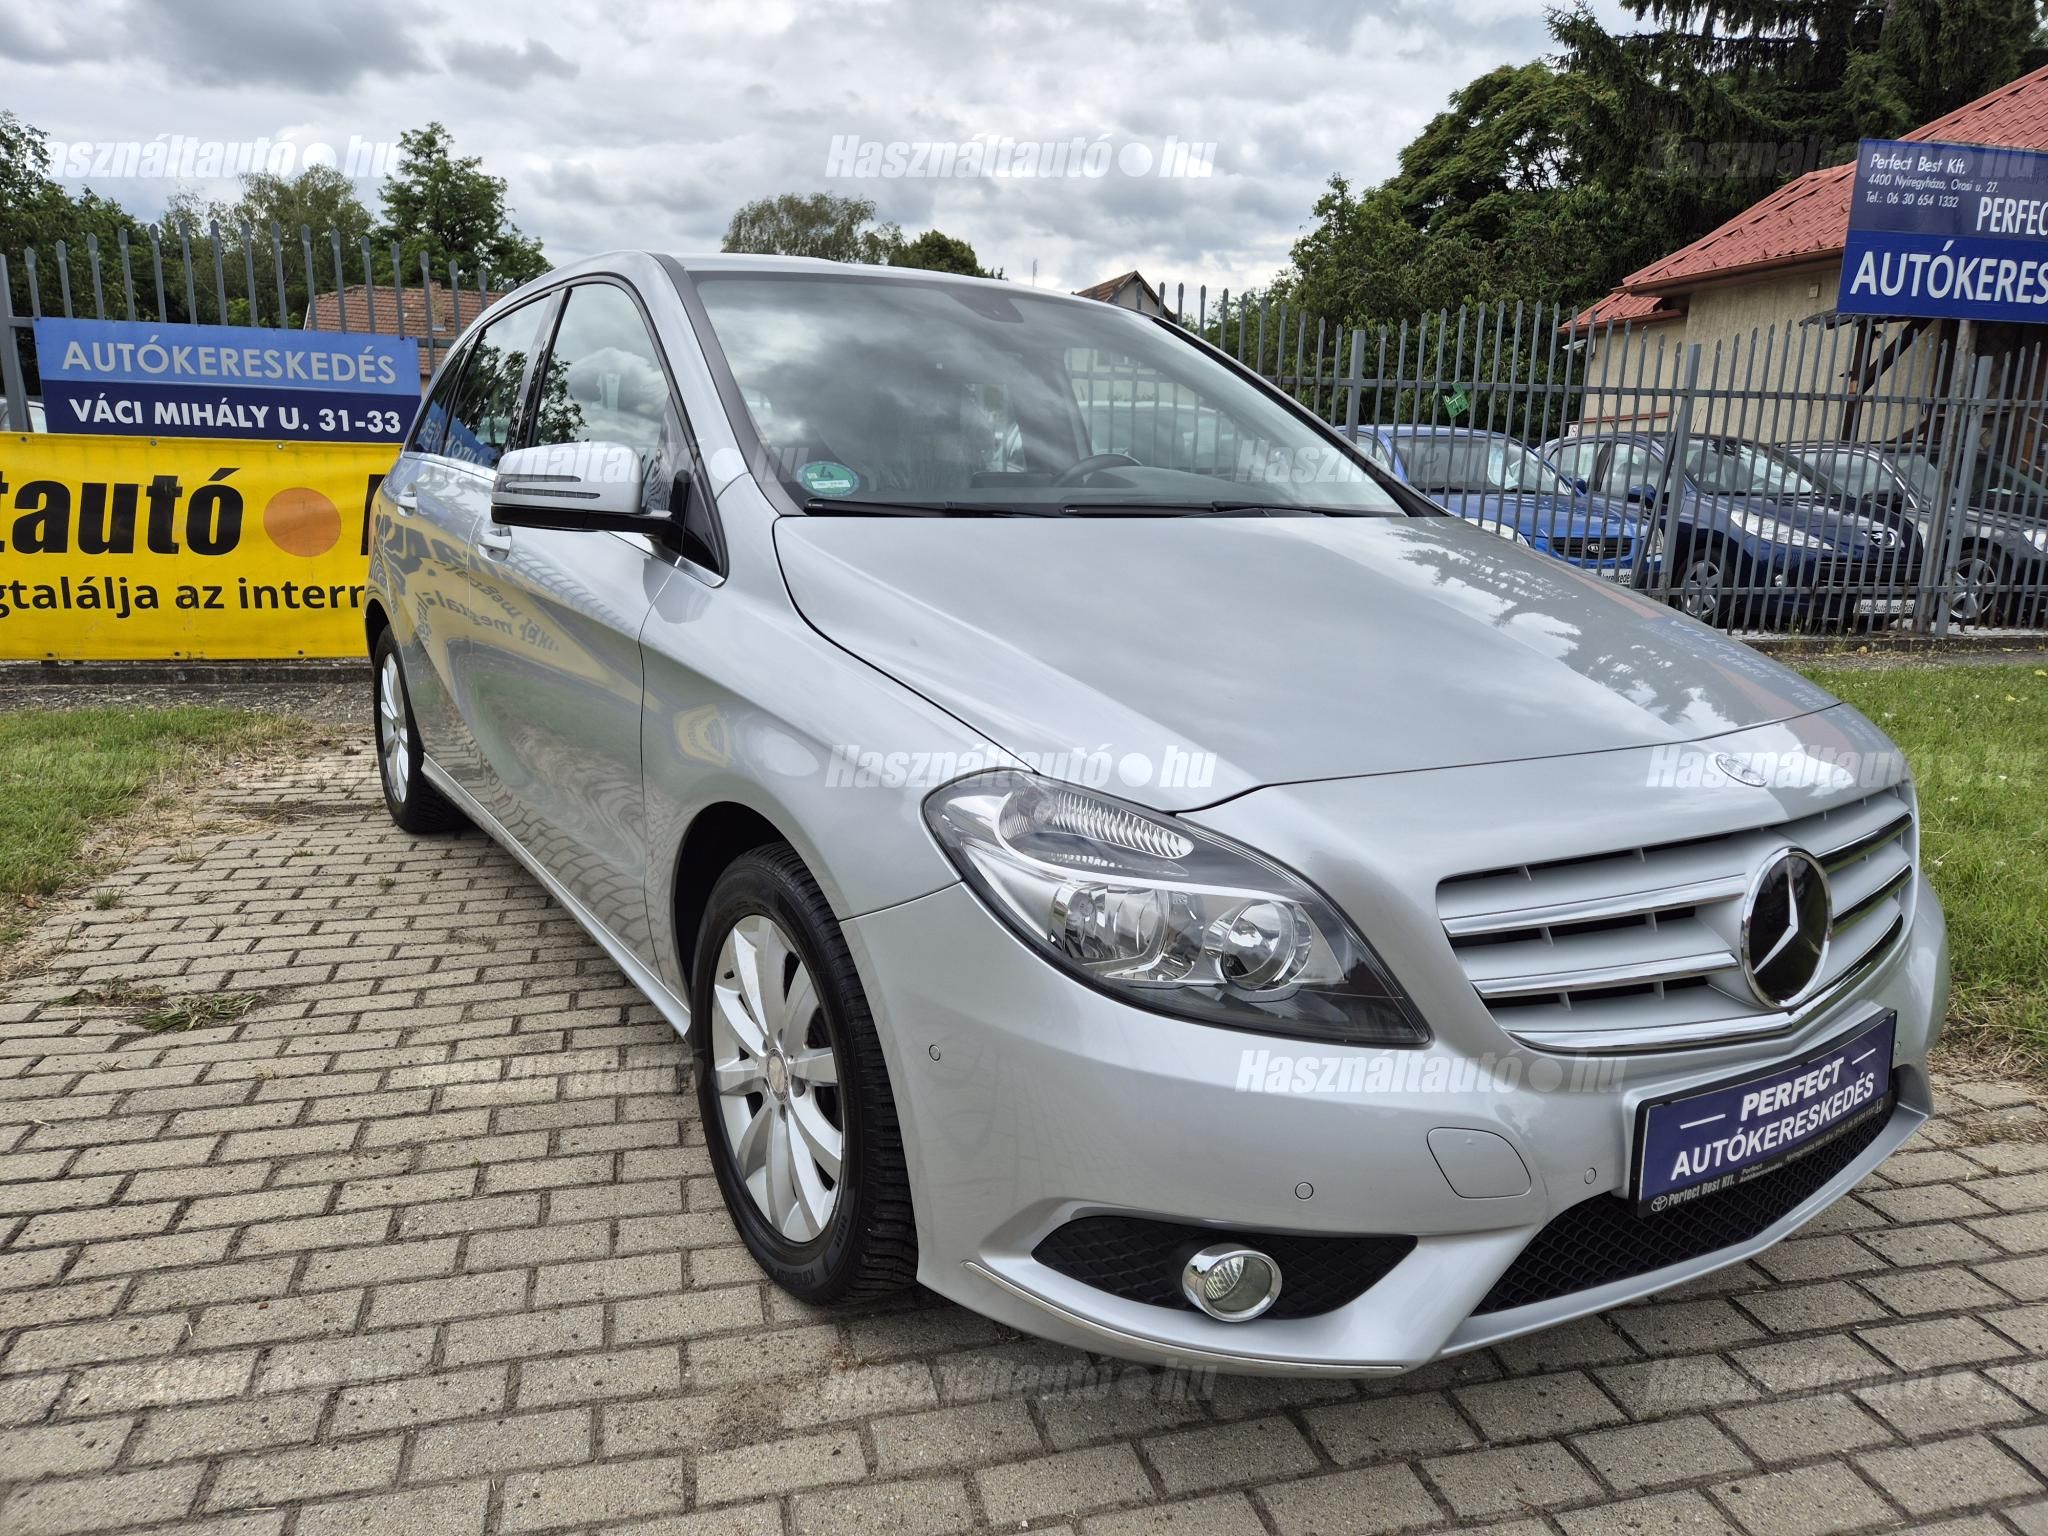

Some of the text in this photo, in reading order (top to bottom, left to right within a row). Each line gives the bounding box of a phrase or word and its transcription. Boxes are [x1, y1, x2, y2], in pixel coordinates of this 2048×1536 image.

[1869, 153, 1967, 175] Perfect Best Kft.
[1868, 174, 1892, 186] 4400
[1986, 181, 1999, 193] 27.
[1887, 192, 1899, 204] 06
[1902, 193, 1915, 205] 30
[1917, 194, 1935, 206] 654
[1938, 195, 1960, 208] 1332
[62, 334, 397, 385] AUTÓKERESKEDÉS
[68, 392, 402, 434] VÁCI MIHÁLY U. 31-33
[0, 467, 244, 556] autó
[175, 584, 225, 609] az
[1740, 1056, 1845, 1122] PERFECT
[1670, 1071, 1876, 1181] AUTÓKERESKEDÉS
[1668, 1185, 1701, 1207] Perfect
[1701, 1179, 1721, 1196] Best
